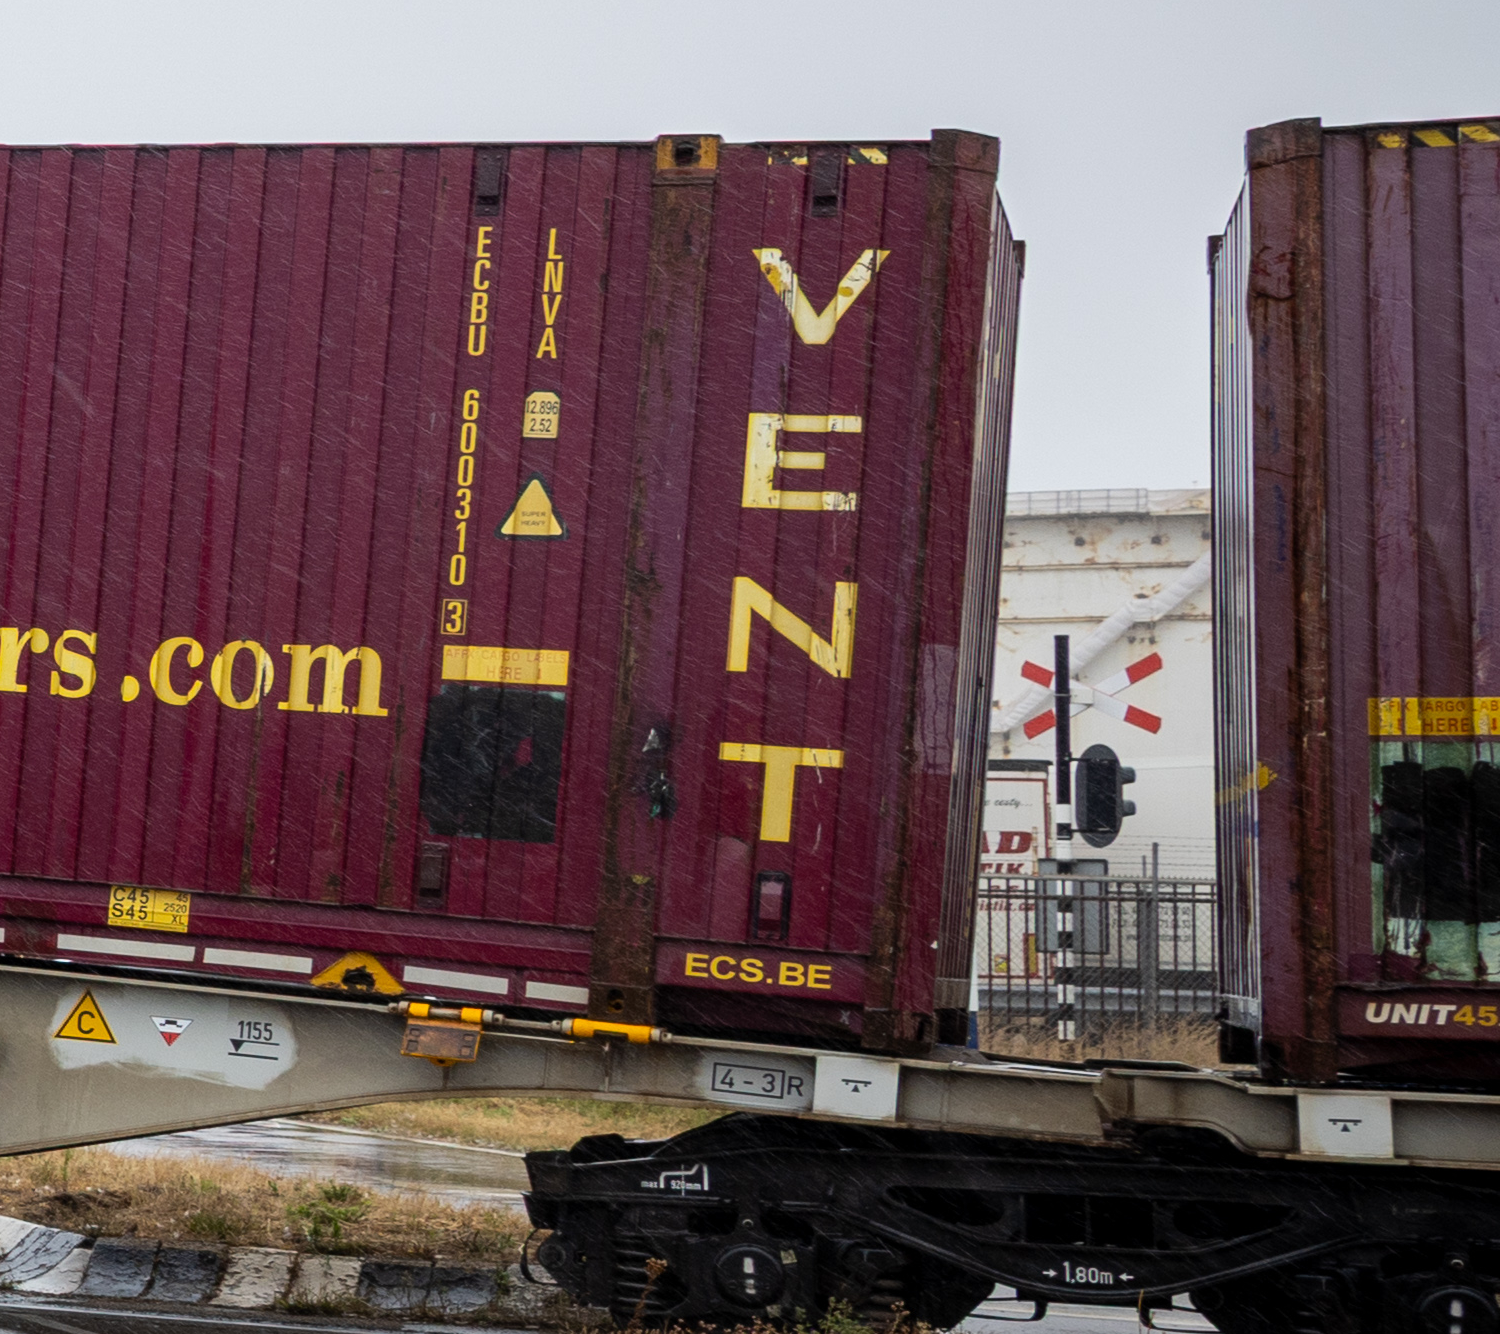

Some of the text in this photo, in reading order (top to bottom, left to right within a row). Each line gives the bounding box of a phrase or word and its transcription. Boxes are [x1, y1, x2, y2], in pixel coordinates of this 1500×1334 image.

[536, 227, 564, 359] LNVA
[525, 400, 559, 415] 12.896
[445, 226, 493, 632] ECBU 600310 3
[529, 418, 552, 432] 2.52
[718, 248, 890, 842] VENT
[1422, 718, 1470, 732] HERE
[113, 887, 188, 905] C45 45
[111, 903, 187, 920] S45 2520
[171, 915, 184, 925] XL
[685, 953, 833, 989] ECS.BE
[77, 1010, 96, 1034] C
[237, 1020, 273, 1041] 1155
[1063, 1261, 1113, 1284] 1,80m
